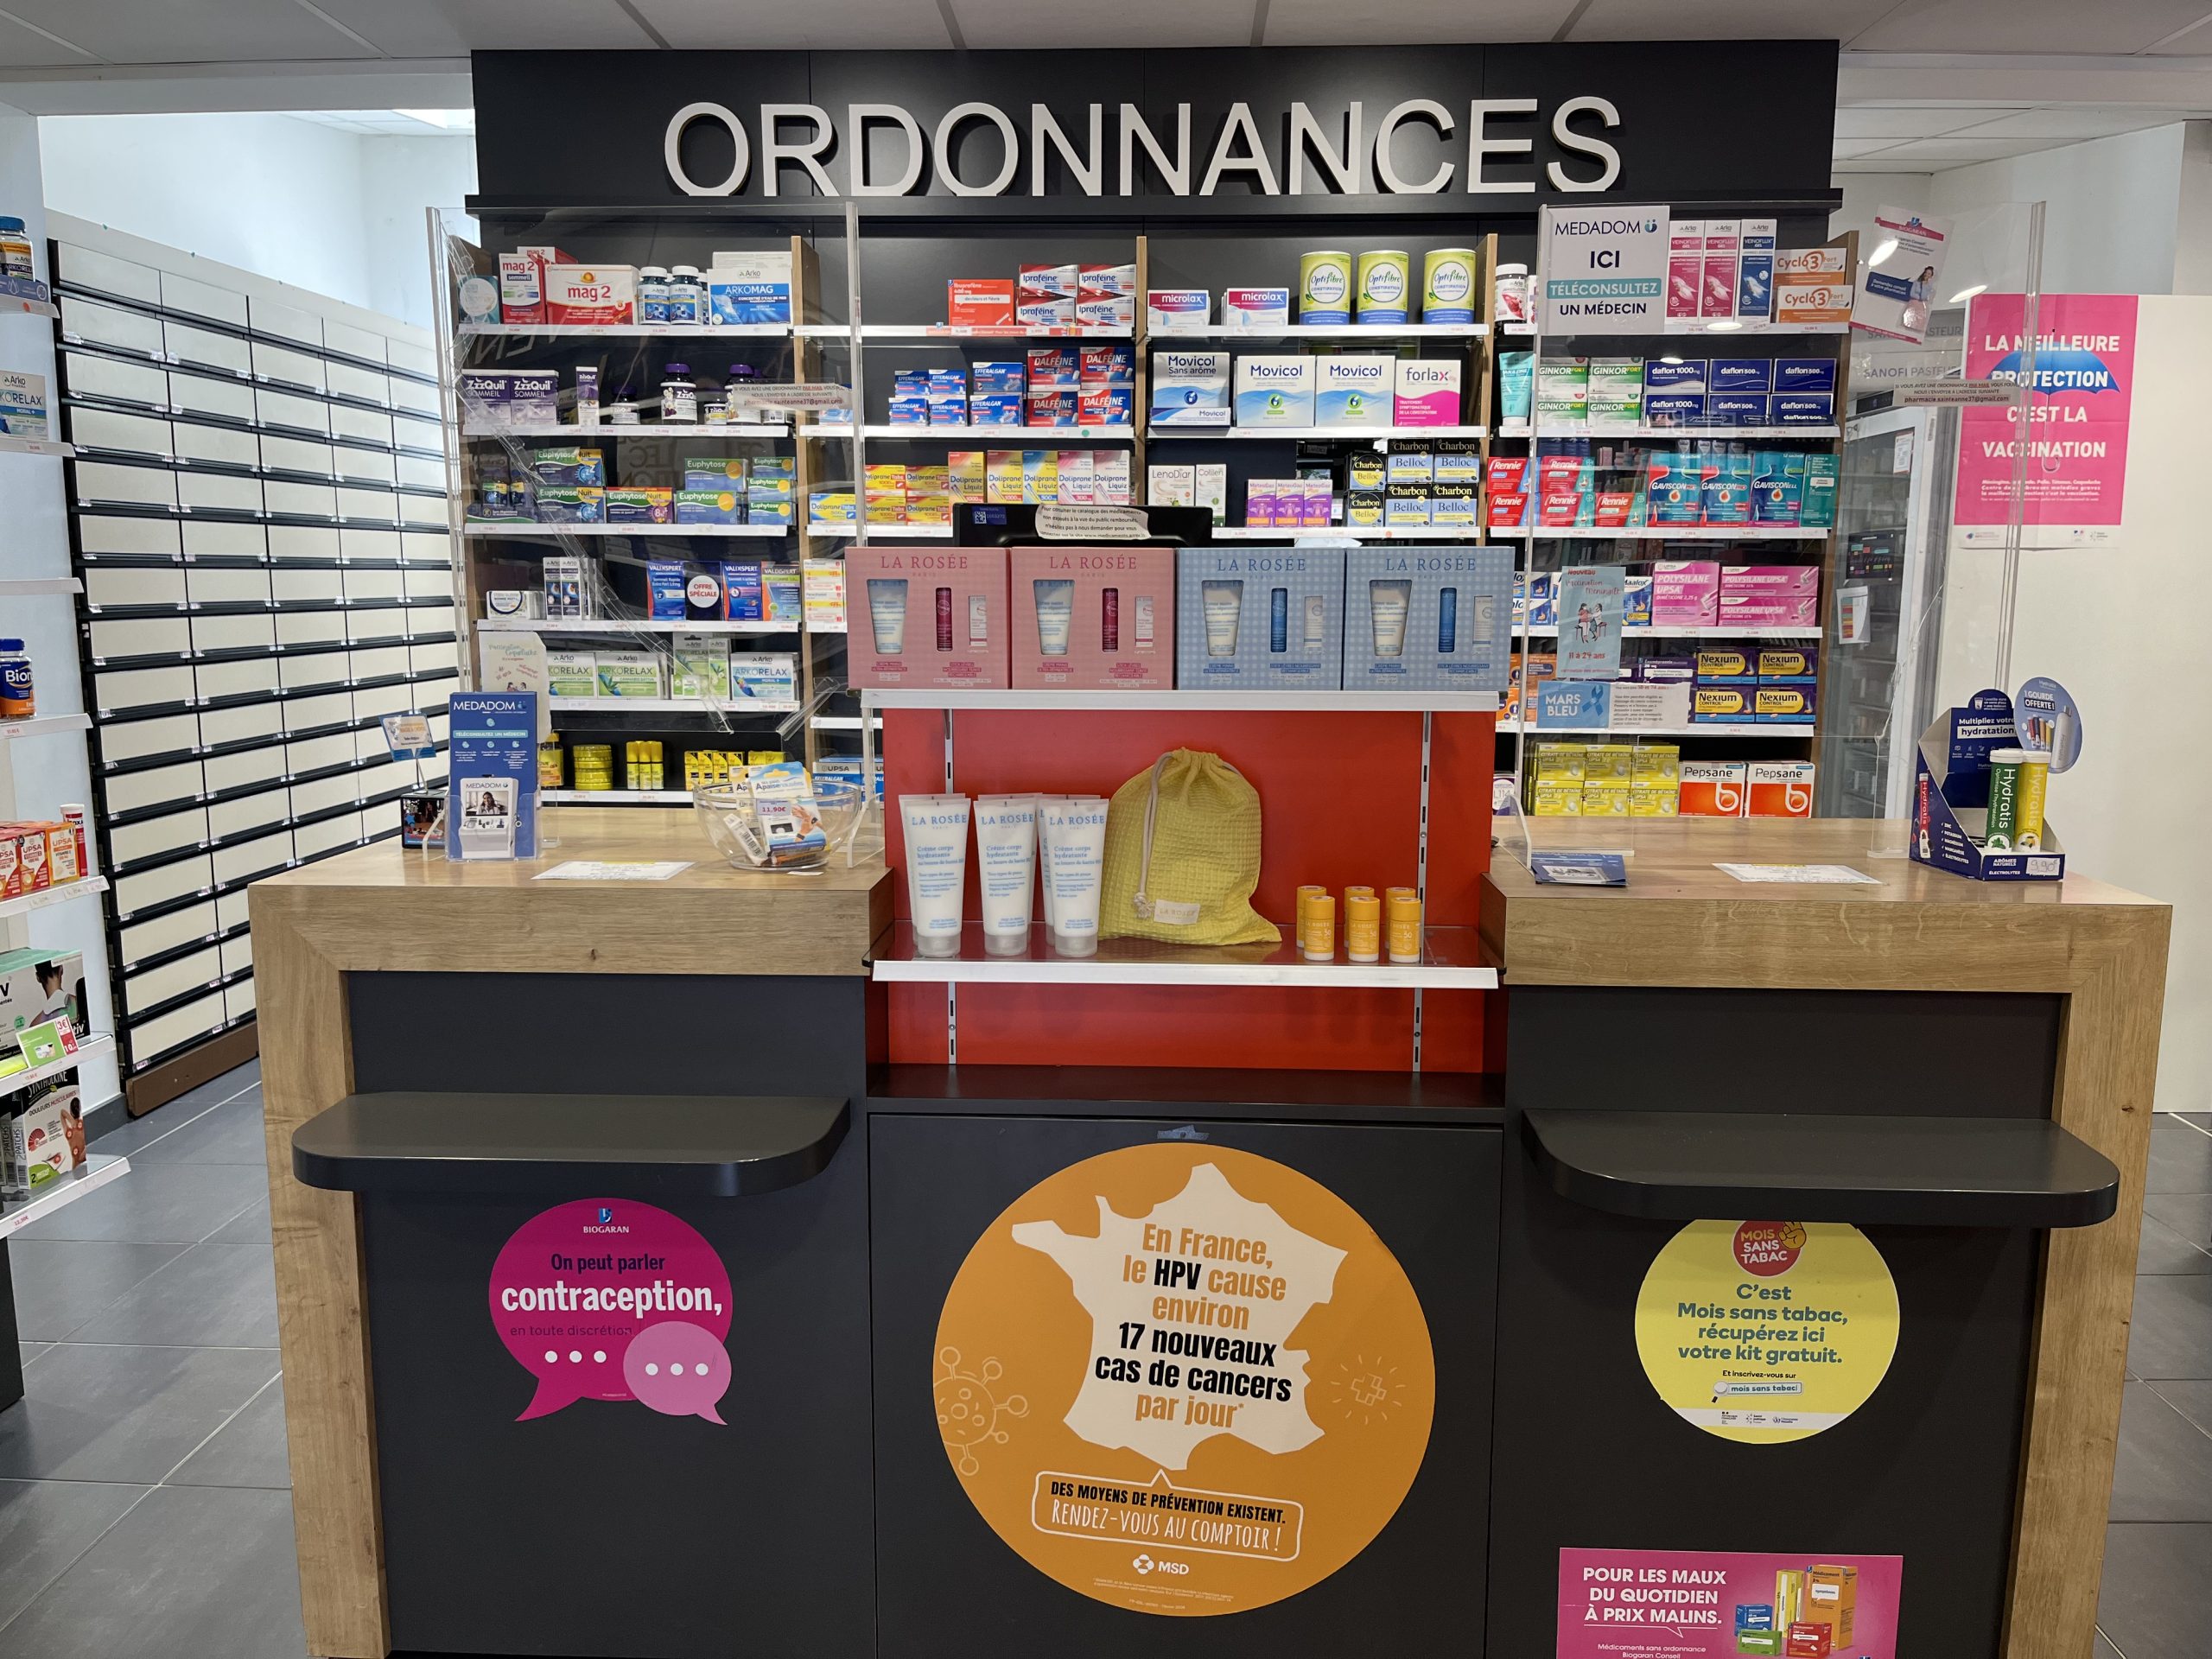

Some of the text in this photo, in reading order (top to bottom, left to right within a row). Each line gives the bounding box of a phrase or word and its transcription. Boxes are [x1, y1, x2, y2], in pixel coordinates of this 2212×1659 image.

[664, 97, 1621, 198] ORDONNANCES
[1555, 220, 1641, 235] MEDADOM
[1590, 251, 1619, 269] ICI
[1777, 257, 1807, 269] Cyclo
[1809, 257, 1820, 270] 3
[503, 262, 535, 273] mag 2
[1310, 273, 1344, 286] Optifibre
[726, 285, 773, 294] ARKOMAG
[1551, 280, 1658, 296] TÉLÉCONSULTEZ
[1162, 294, 1202, 304] microlax
[1560, 301, 1646, 315] UN MÉDECIN
[1986, 335, 2120, 352] LA MEILLEURE
[1034, 357, 1073, 367] DALFÉINE
[1167, 355, 1215, 367] Movicol
[1168, 366, 1217, 376] Sans arôme
[1406, 367, 1448, 382] forlax
[1539, 366, 1571, 376] GINKOR
[1864, 367, 1908, 378] SANOFI
[514, 377, 550, 391] ZzzQuil
[1991, 371, 2108, 387] PROTECTION
[2063, 406, 2088, 423] LA
[1982, 442, 2106, 458] VACCINATION
[687, 460, 726, 469] Euphytose
[1355, 461, 1382, 470] Charbon
[1494, 461, 1522, 471] Rennie
[950, 476, 982, 486] Doliprane
[1152, 468, 1192, 480] LenoDiar
[1357, 473, 1379, 481] Belloc
[963, 483, 983, 492] Liquiz
[1652, 481, 1687, 490] GAVISCON
[811, 503, 841, 512] Doliprane
[880, 553, 968, 569] LA ROSÉE
[1050, 554, 1137, 569] LA ROSÉE
[1217, 556, 1306, 571] LA ROSÉE
[1386, 556, 1476, 571] LA ROSÉE
[1657, 575, 1710, 583] POLYSILANE
[690, 588, 717, 597] SPÉCIALE
[1656, 586, 1681, 594] UPSA
[598, 666, 652, 676] ARKORELAX
[1546, 694, 1580, 705] MARS
[2028, 691, 2054, 700] GOURDE
[454, 702, 516, 710] MEDADOM
[1547, 706, 1578, 716] BLEU
[2025, 699, 2051, 709] OFFERTE
[1684, 767, 1732, 779] Pepsane
[1999, 768, 2016, 829] Hydratis
[57, 1020, 67, 1030] 3€
[1741, 1229, 1775, 1243] MOIS
[1142, 1223, 1274, 1269] En France,
[1744, 1241, 1780, 1253] SANS
[551, 1254, 664, 1274] On peut parler
[1741, 1251, 1788, 1264] TABAC
[1123, 1255, 1287, 1301] le HPV cause
[1736, 1283, 1792, 1300] C’est
[501, 1281, 722, 1319] contraception,
[1153, 1294, 1250, 1331] environ
[1678, 1302, 1847, 1325] Mois sans tabac,
[511, 1325, 632, 1336] en toute discrétion
[1698, 1323, 1825, 1344] récupérez ici
[1119, 1322, 1277, 1368] 17 nouveaux
[1678, 1344, 1842, 1366] votre kit gratuit.
[1095, 1355, 1293, 1403] cas de cancers
[1135, 1392, 1179, 1421] par
[1051, 1481, 1287, 1524] DES MOYENS DE PRÉVENTION EXISTENT.
[1052, 1498, 1281, 1552] RENDEZ-VOUS AU COMPTOIR !
[1158, 1560, 1190, 1575] MSD
[1583, 1567, 1727, 1585] POUR LES MAUX
[1589, 1587, 1719, 1605] DU QUOTIDIEN
[1584, 1604, 1722, 1625] À PRIX MALINS.
[1598, 1643, 1644, 1652] Médicaments
